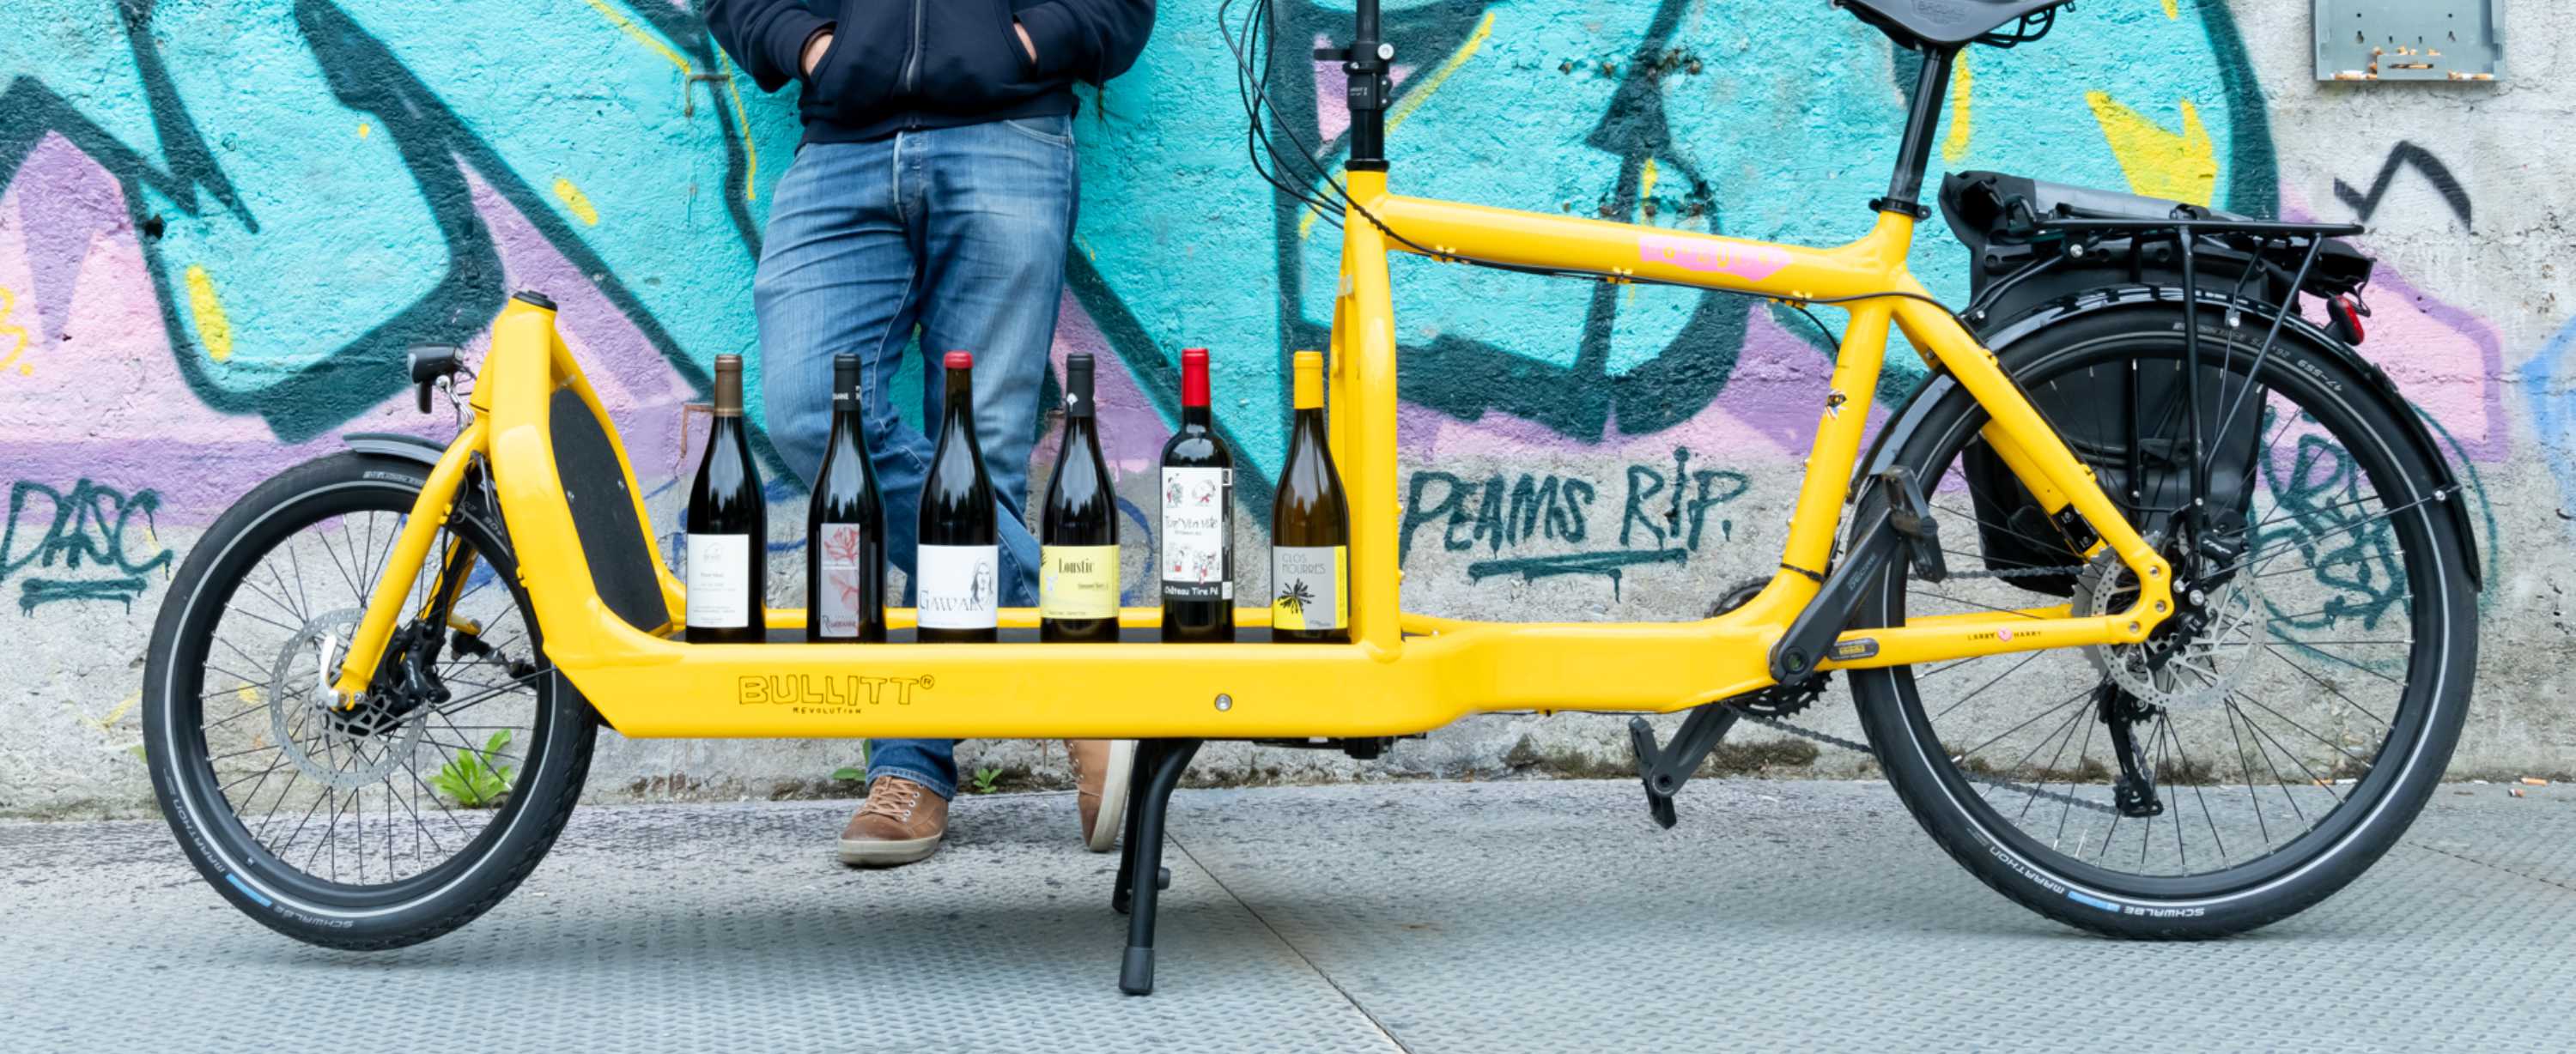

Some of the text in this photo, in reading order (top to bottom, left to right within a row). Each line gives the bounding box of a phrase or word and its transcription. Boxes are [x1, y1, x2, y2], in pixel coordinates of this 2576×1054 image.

[1058, 557, 1094, 573] Loustic
[1282, 553, 1307, 563] CLOS
[172, 797, 226, 874] MARATHON
[1989, 845, 2066, 894] MARATHON
[273, 905, 355, 930] SCHWALBE
[2123, 906, 2205, 918] SCHWALBE
